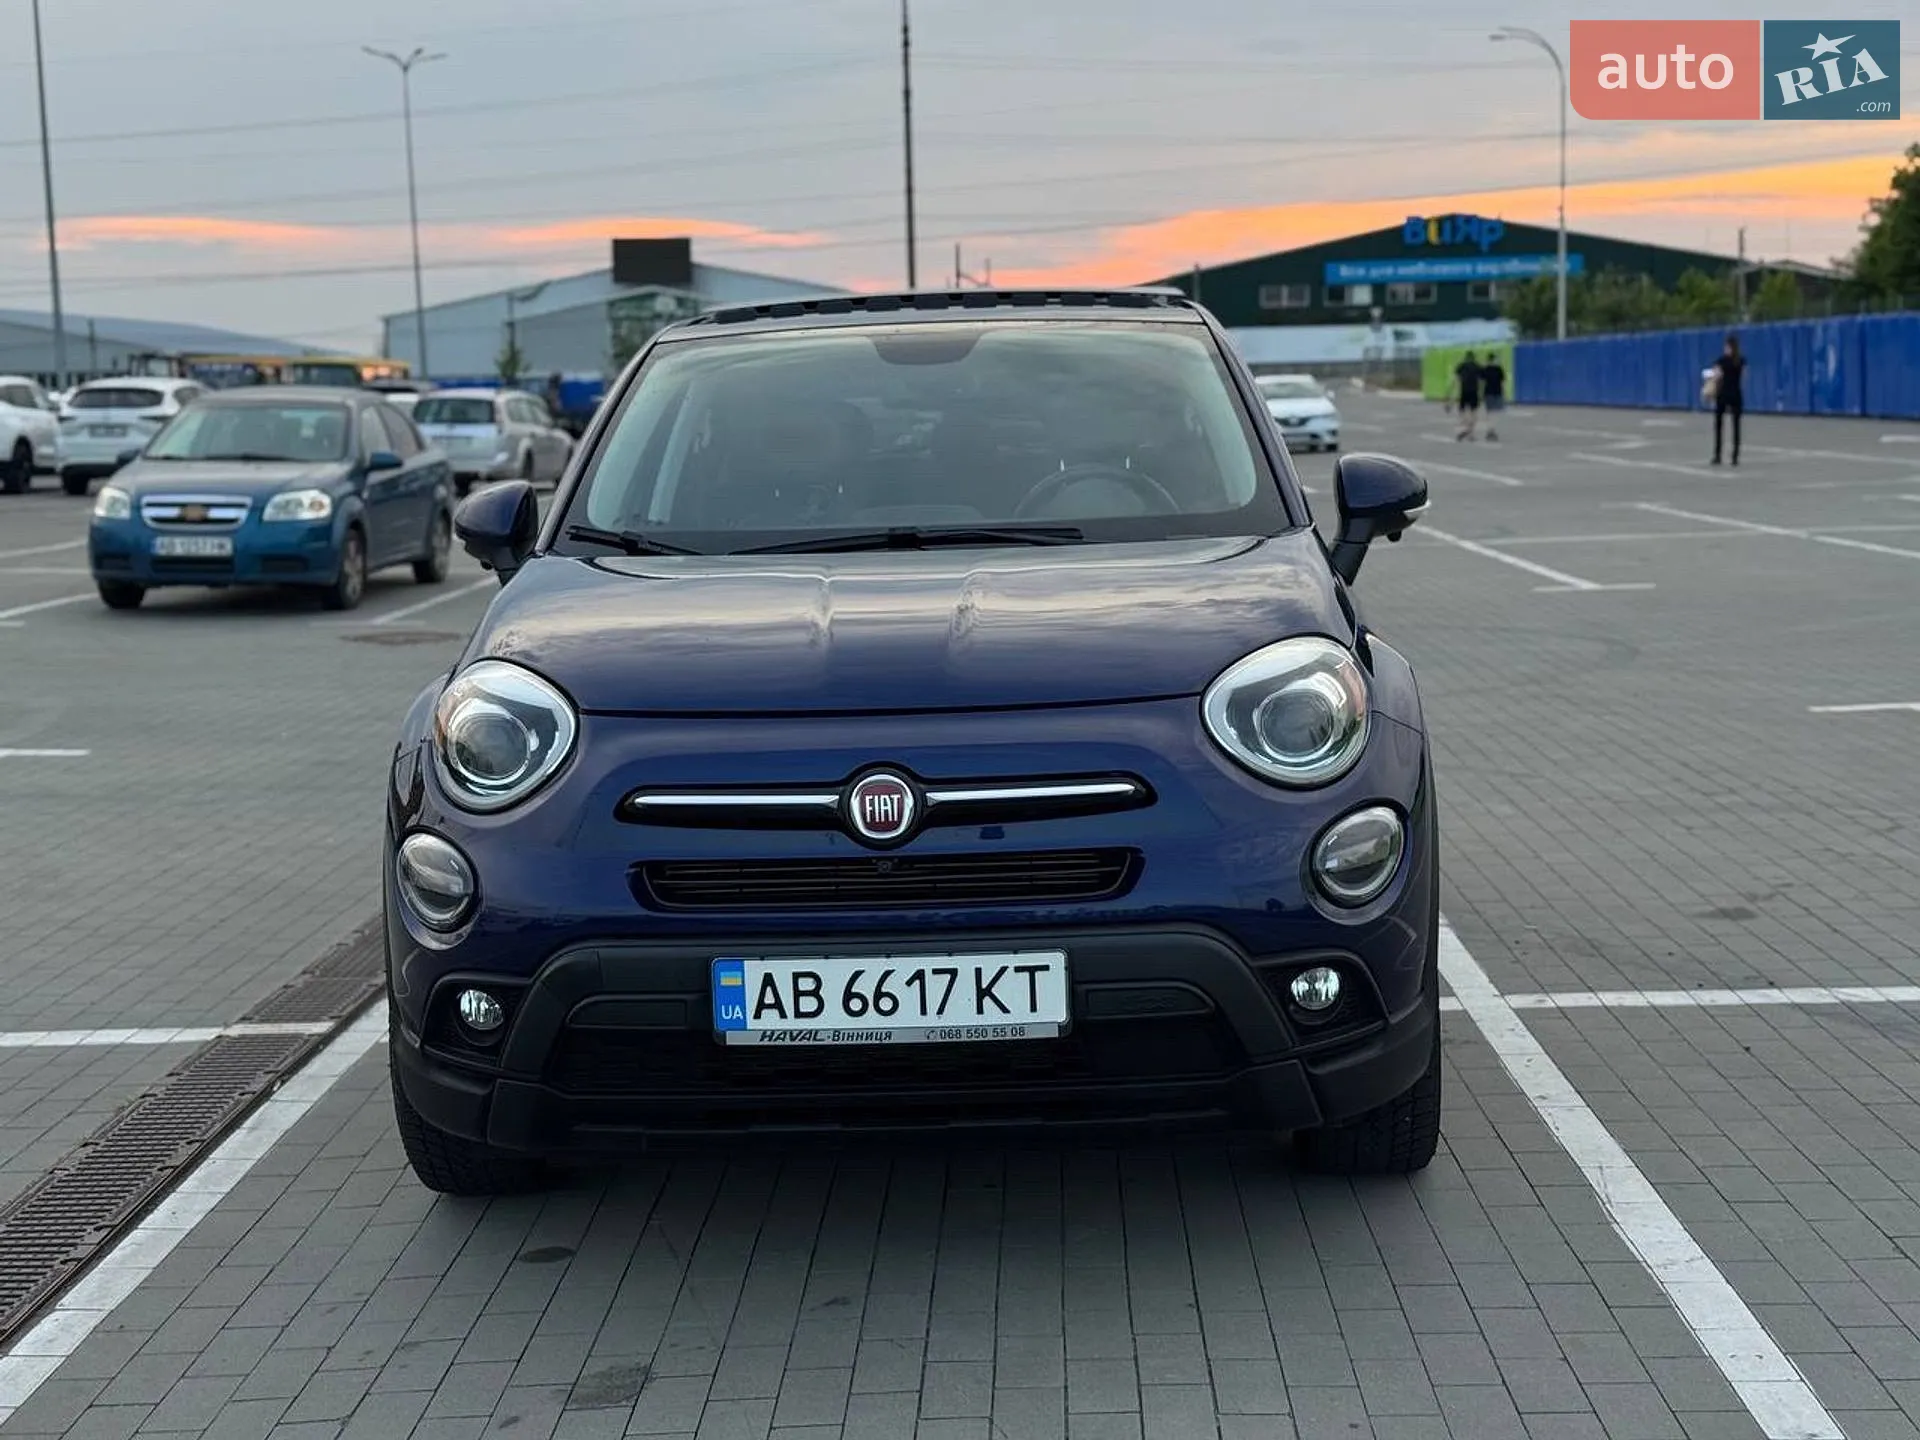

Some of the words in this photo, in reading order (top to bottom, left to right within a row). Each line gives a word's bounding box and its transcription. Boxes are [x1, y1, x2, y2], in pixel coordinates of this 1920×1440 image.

[865, 794, 901, 823] FIAT
[752, 970, 826, 1020] AB
[841, 967, 960, 1018] 6617
[974, 964, 1051, 1016] KT
[721, 1005, 744, 1021] UA
[760, 1030, 825, 1042] HAVAL
[940, 1028, 962, 1040] 068
[966, 1027, 988, 1039] 550
[992, 1026, 1007, 1038] 55
[1010, 1026, 1026, 1037] 08
